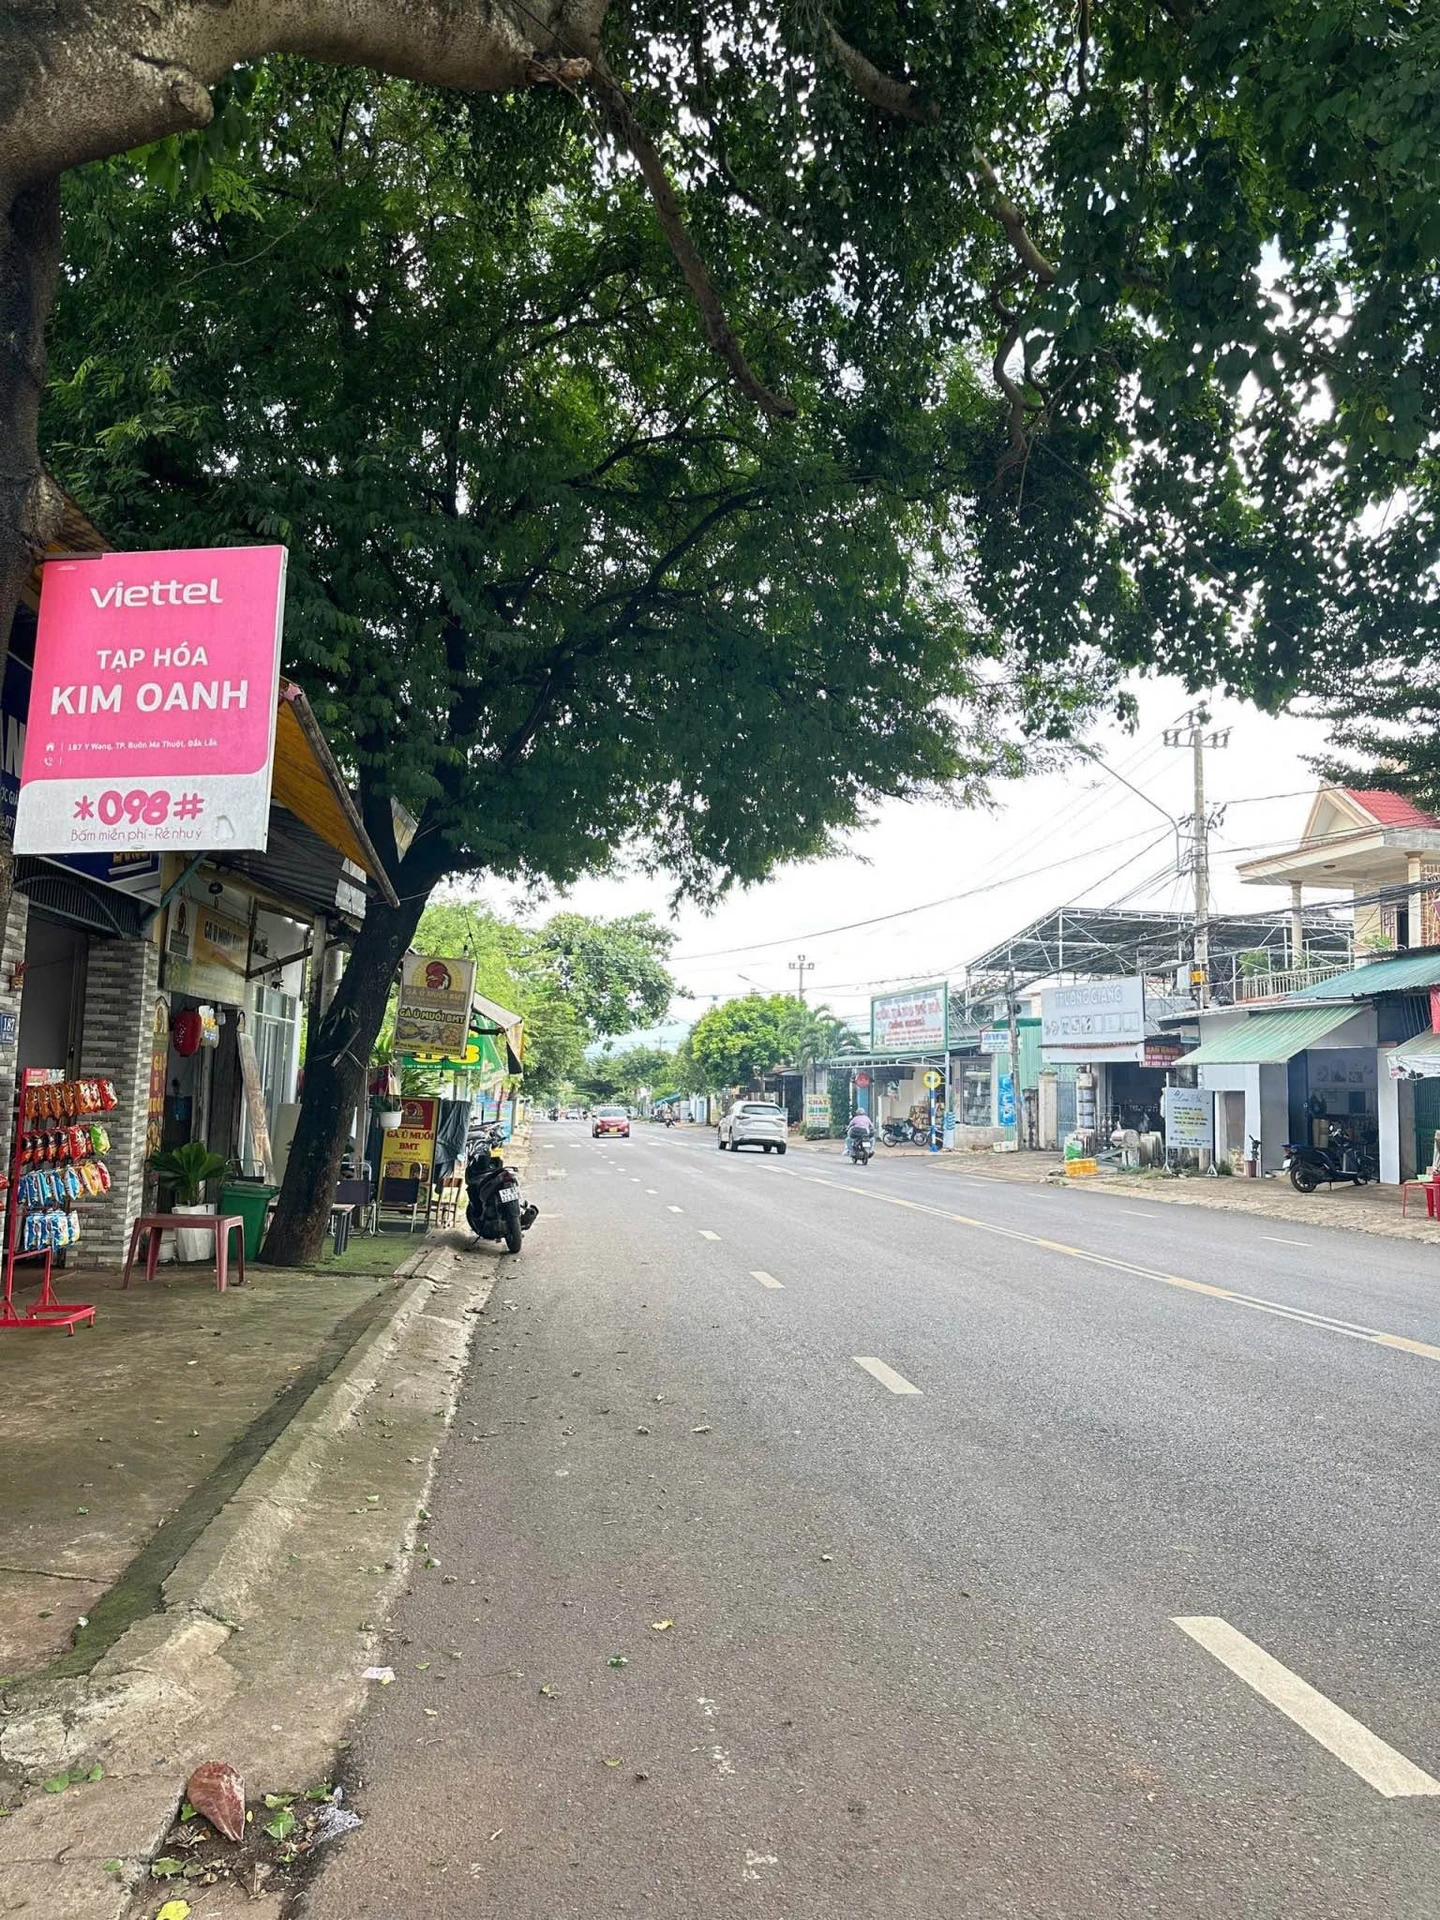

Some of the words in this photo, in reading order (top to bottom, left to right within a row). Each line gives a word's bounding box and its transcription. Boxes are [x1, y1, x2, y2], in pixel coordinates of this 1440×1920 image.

[90, 578, 223, 608] viettel
[97, 648, 145, 673] TẠP
[153, 641, 208, 667] HÓA
[50, 684, 123, 716] KIM
[136, 680, 248, 713] OANH
[71, 829, 96, 842] Bấm
[399, 1007, 411, 1017] GÀ
[446, 1014, 466, 1024] BMT
[3, 1018, 15, 1031] 187
[386, 1129, 399, 1139] GÀ
[399, 1142, 420, 1150] BMT
